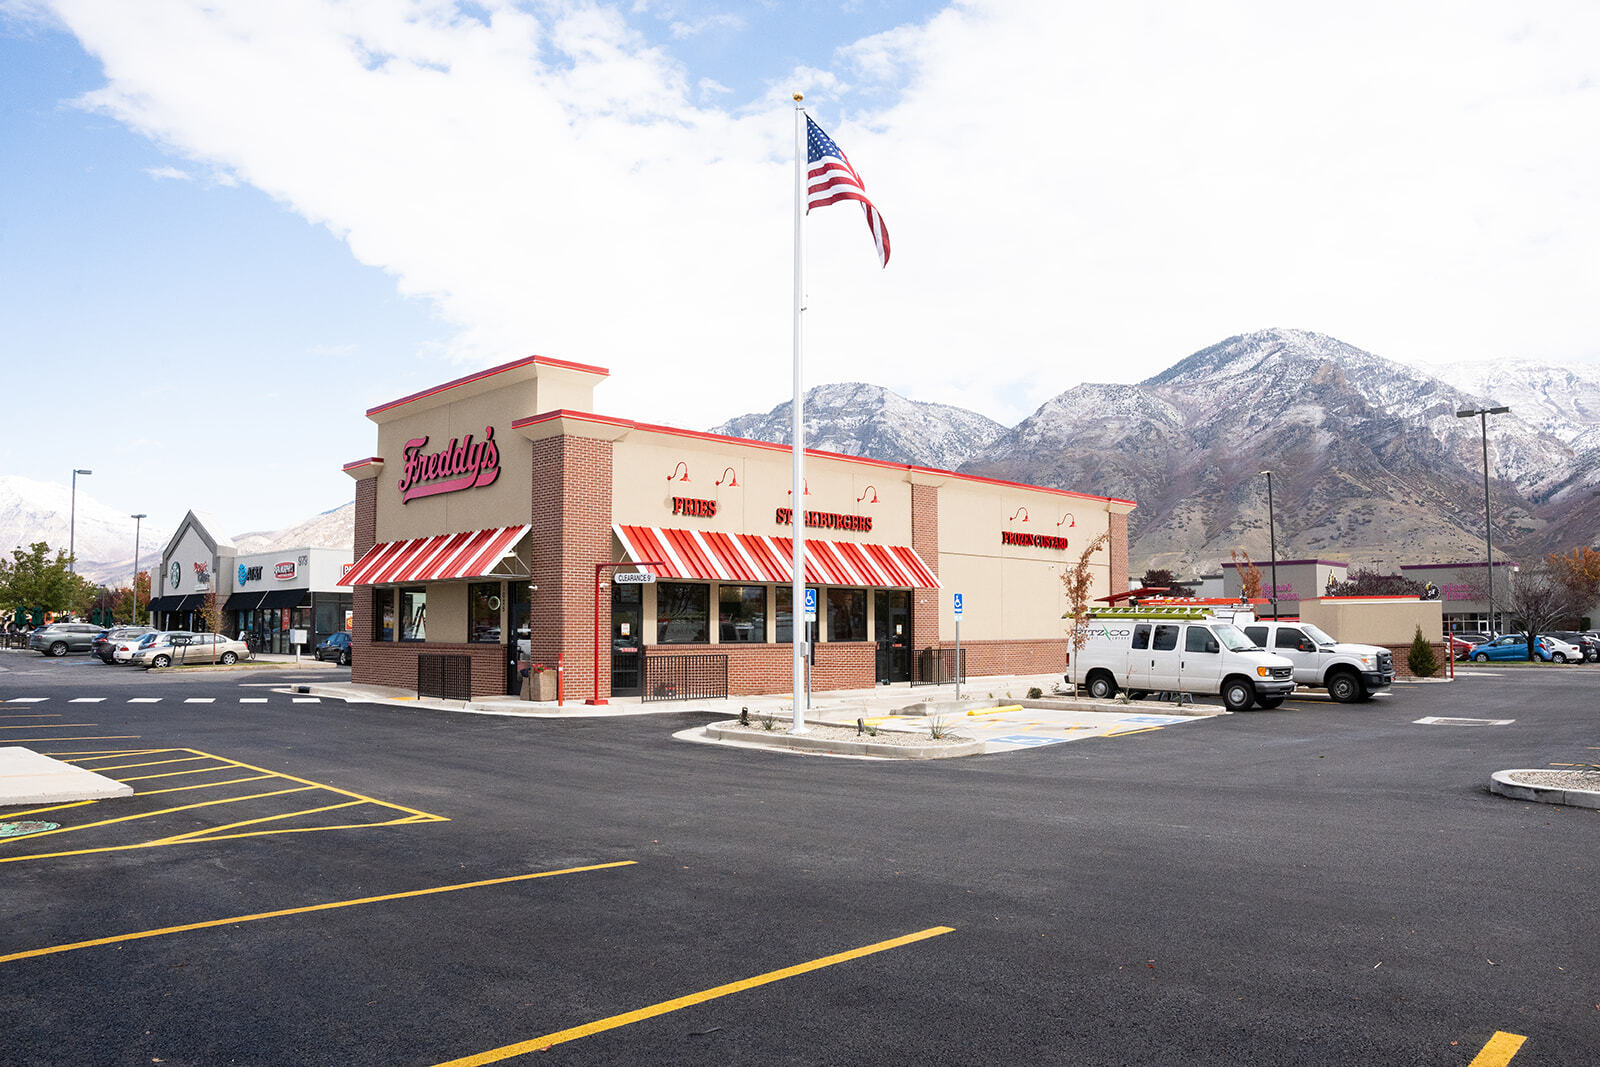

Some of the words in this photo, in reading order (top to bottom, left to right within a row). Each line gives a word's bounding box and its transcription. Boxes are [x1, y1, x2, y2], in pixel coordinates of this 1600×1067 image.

[398, 425, 501, 504] Freddy's
[672, 496, 717, 517] FRIES
[775, 507, 873, 532] STAKBURGERS
[1001, 531, 1034, 546] FROZEN
[1034, 534, 1069, 550] CUSTARD
[618, 574, 646, 582] CLEARANCE
